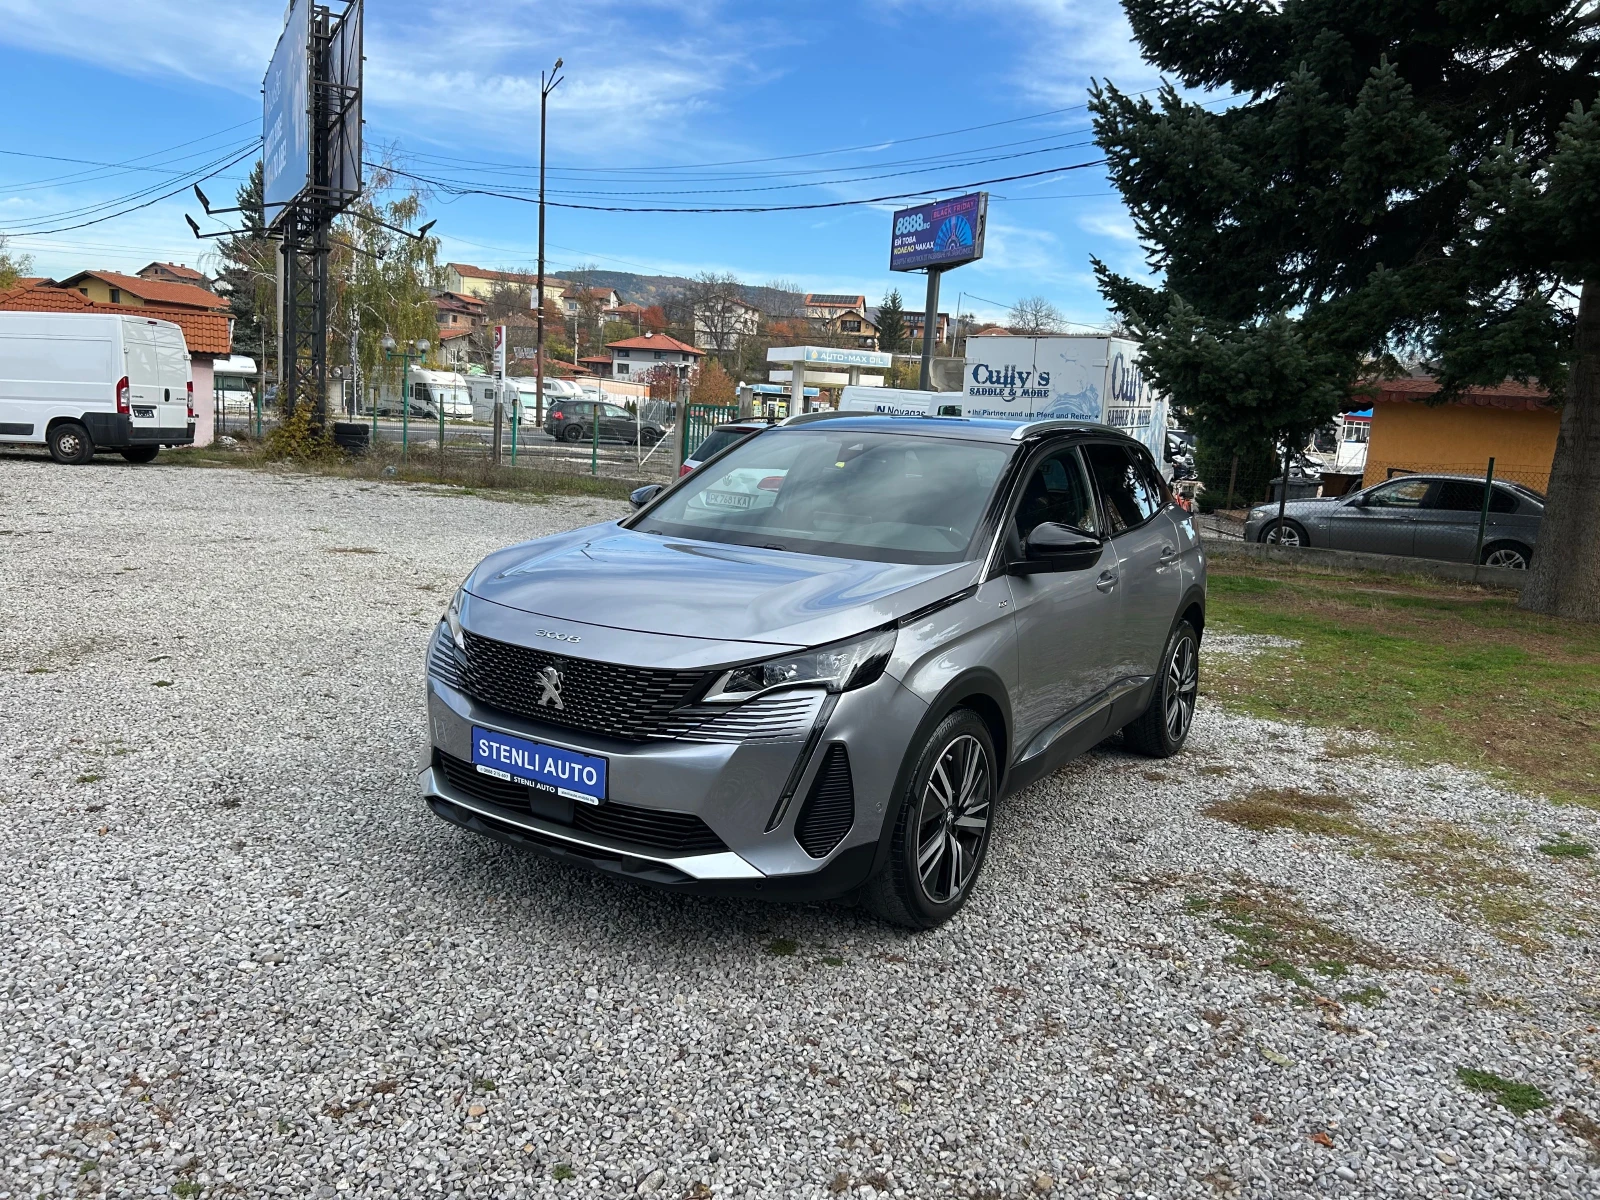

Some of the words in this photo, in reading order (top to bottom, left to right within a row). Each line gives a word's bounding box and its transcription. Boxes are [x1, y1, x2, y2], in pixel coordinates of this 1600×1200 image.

[933, 208, 952, 218] BLACK
[954, 201, 974, 212] FRIDAY
[902, 236, 916, 244] ТОВА
[916, 241, 934, 250] ЧАКАХ
[1008, 388, 1016, 396] &
[1107, 410, 1129, 426] SADDLE
[535, 629, 581, 644] 3008
[479, 739, 539, 771] STENLI
[544, 758, 597, 785] AUTO
[514, 777, 535, 787] STENLI
[536, 783, 556, 793] AUTO
